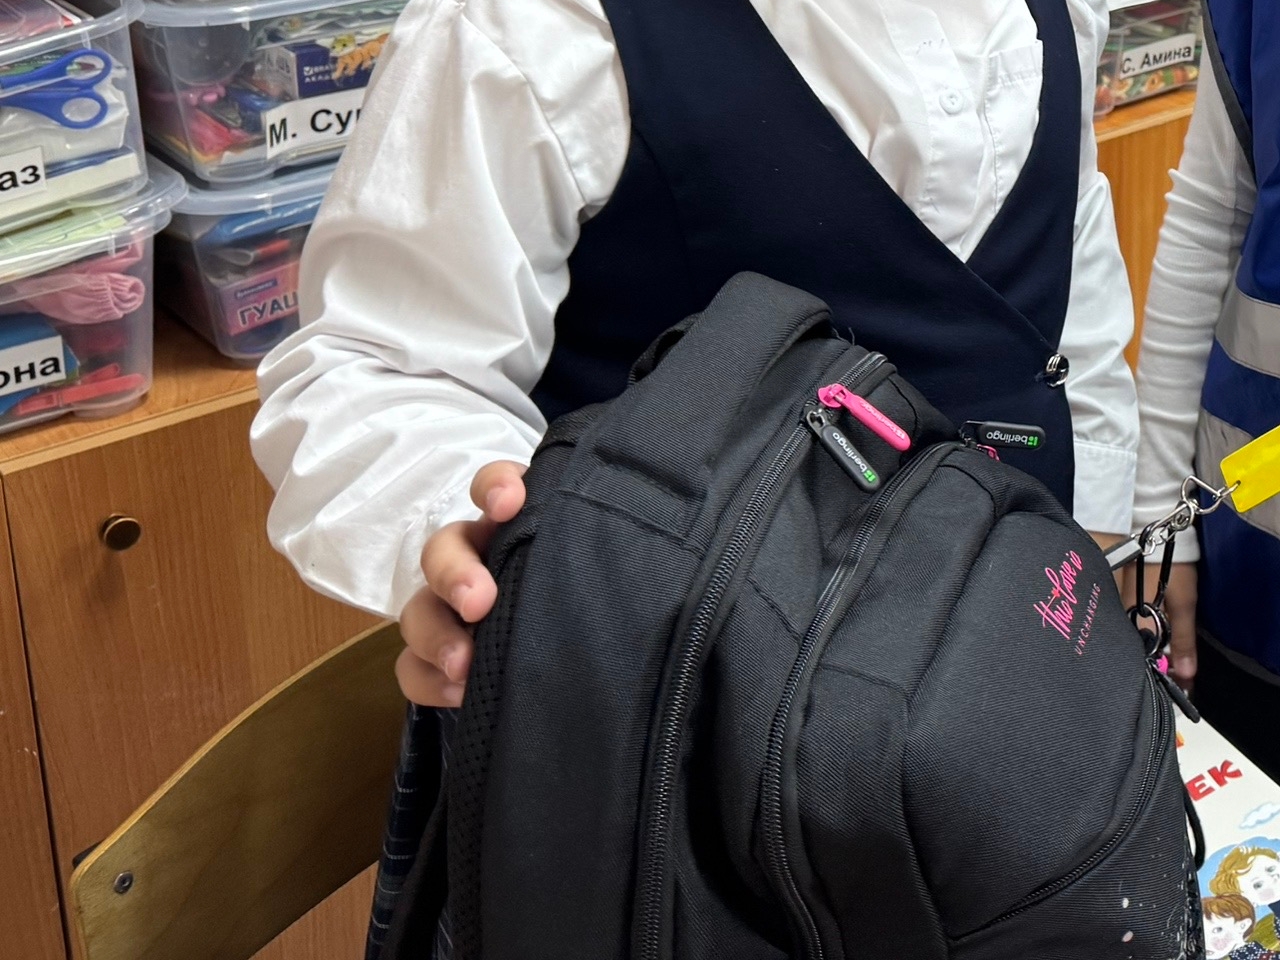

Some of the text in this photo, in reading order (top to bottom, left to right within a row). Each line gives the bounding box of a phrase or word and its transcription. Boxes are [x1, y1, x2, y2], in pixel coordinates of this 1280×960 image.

[1121, 45, 1193, 75] С. Амина
[269, 117, 297, 149] М.
[832, 431, 869, 474] berlingo
[985, 430, 1029, 446] berlingo
[1075, 583, 1101, 656] UNCHANGING
